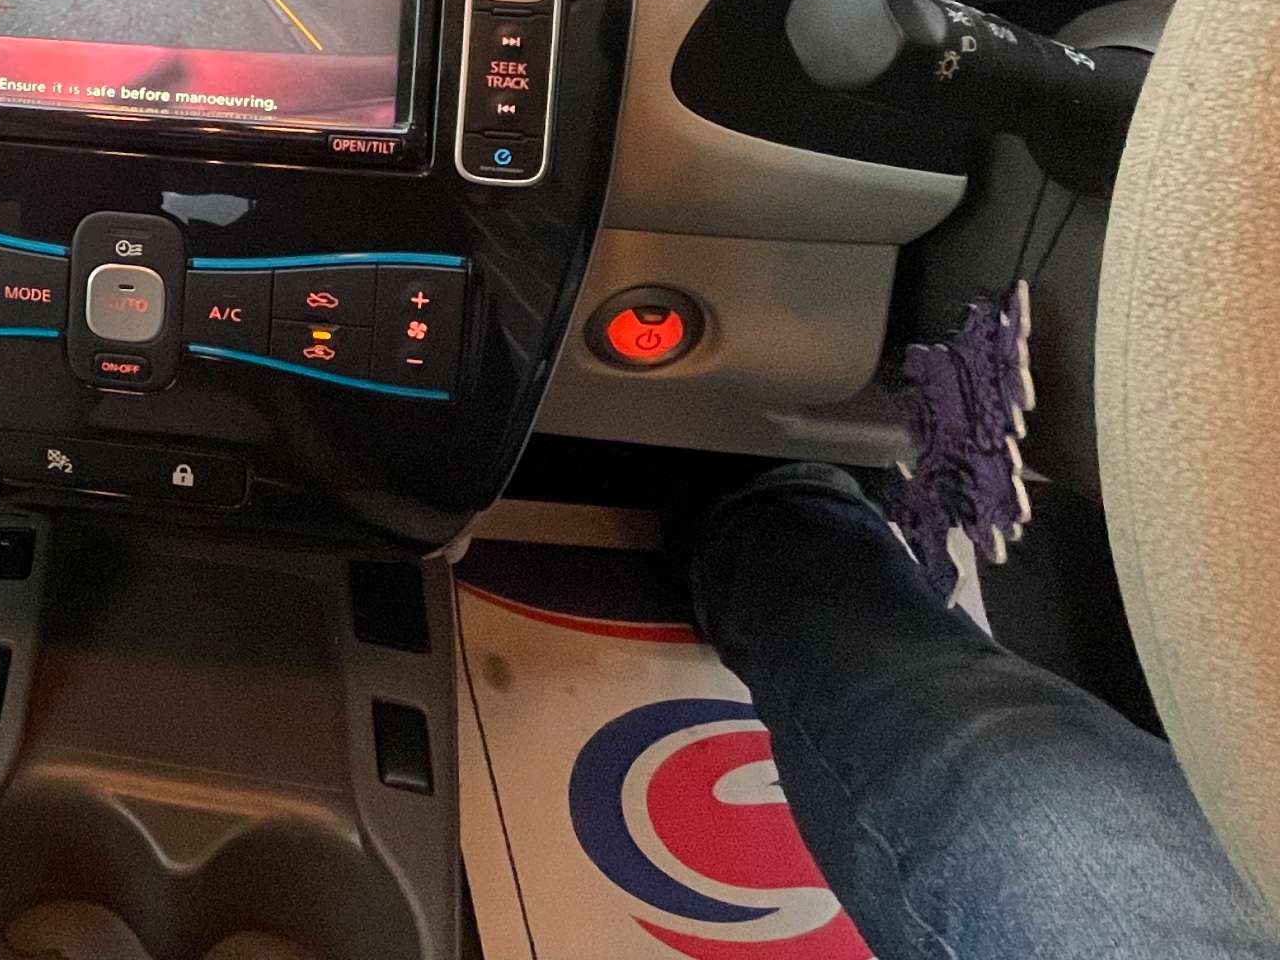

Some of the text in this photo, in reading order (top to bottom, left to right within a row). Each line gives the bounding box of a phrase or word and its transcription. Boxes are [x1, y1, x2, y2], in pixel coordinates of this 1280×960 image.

[491, 61, 528, 75] SEEK
[486, 75, 530, 90] TRACK
[0, 77, 278, 112] Ensure it is safe before manoeuvring.
[332, 138, 396, 154] OPEN/TILT
[4, 285, 52, 303] MODE
[208, 305, 243, 322] A/C
